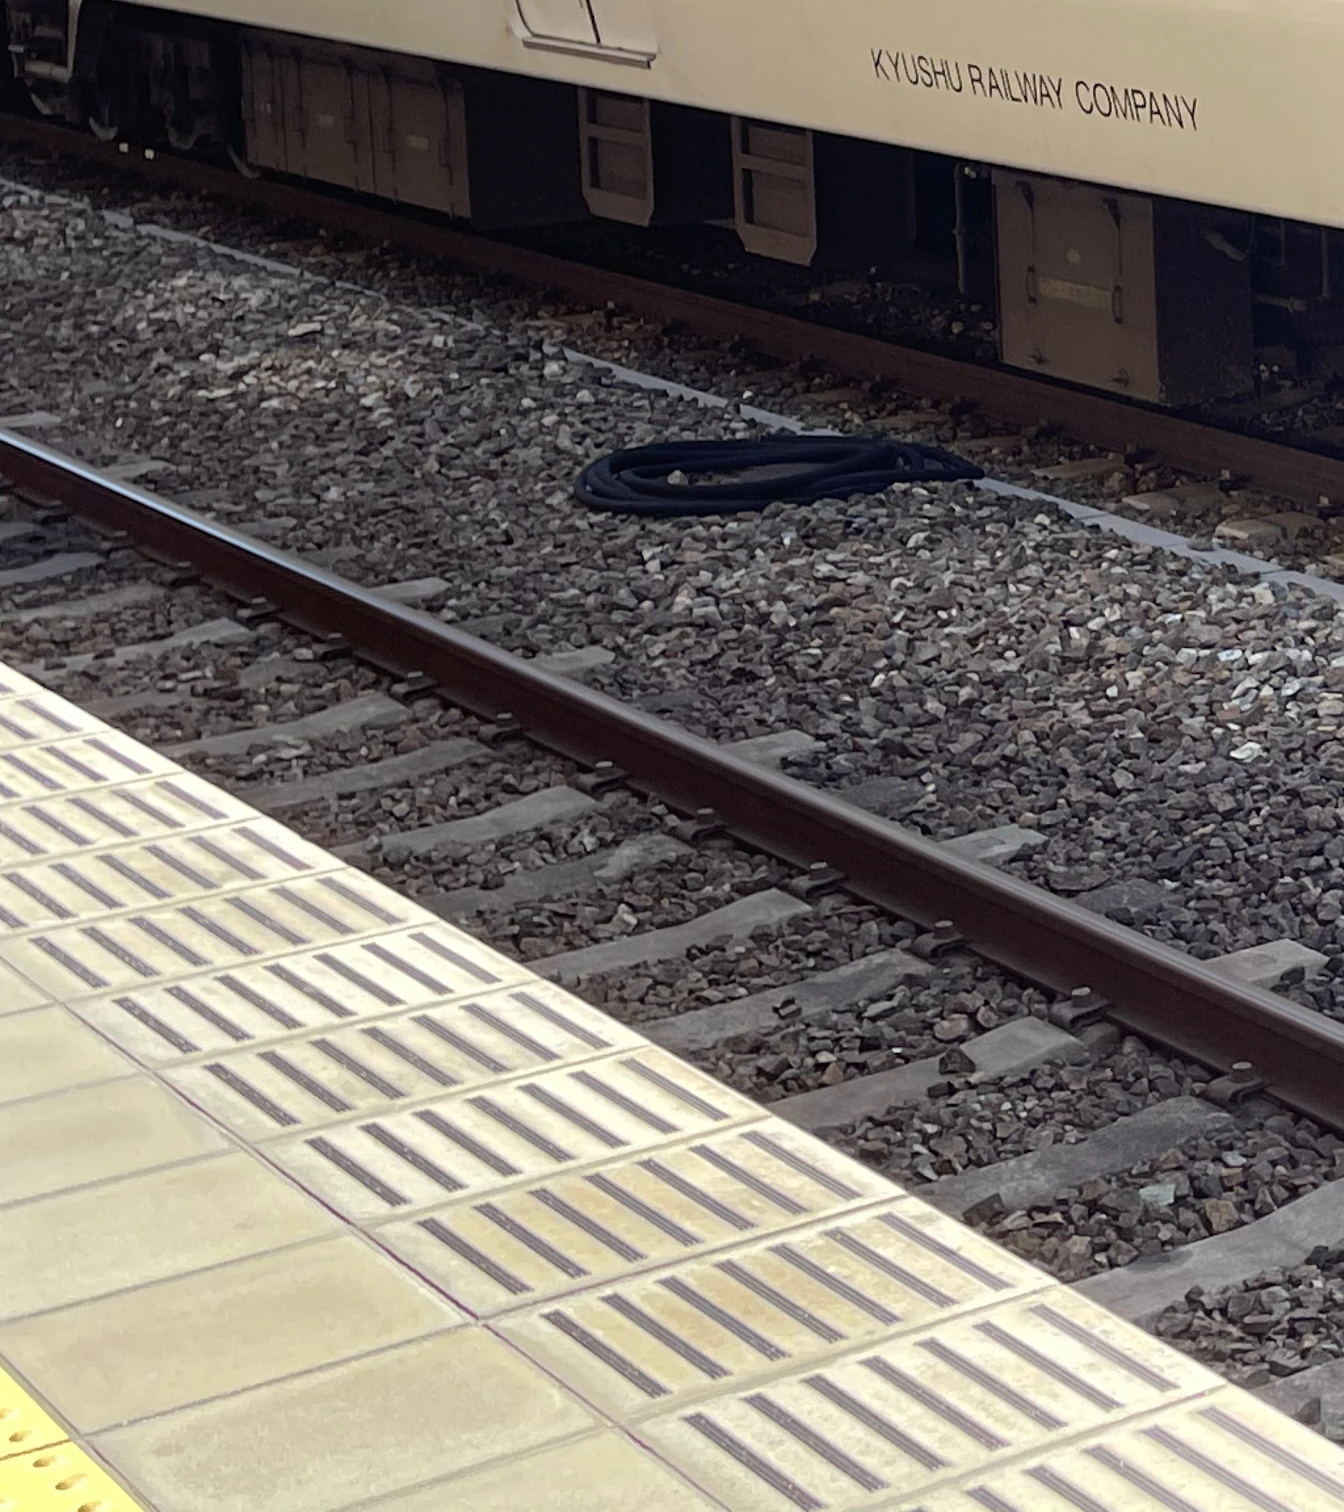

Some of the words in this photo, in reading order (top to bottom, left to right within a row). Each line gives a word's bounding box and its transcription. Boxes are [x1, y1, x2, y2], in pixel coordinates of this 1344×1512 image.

[869, 47, 963, 93] KYUSHU
[967, 63, 1063, 109] RAILWAY
[1074, 80, 1198, 131] COMPANY
